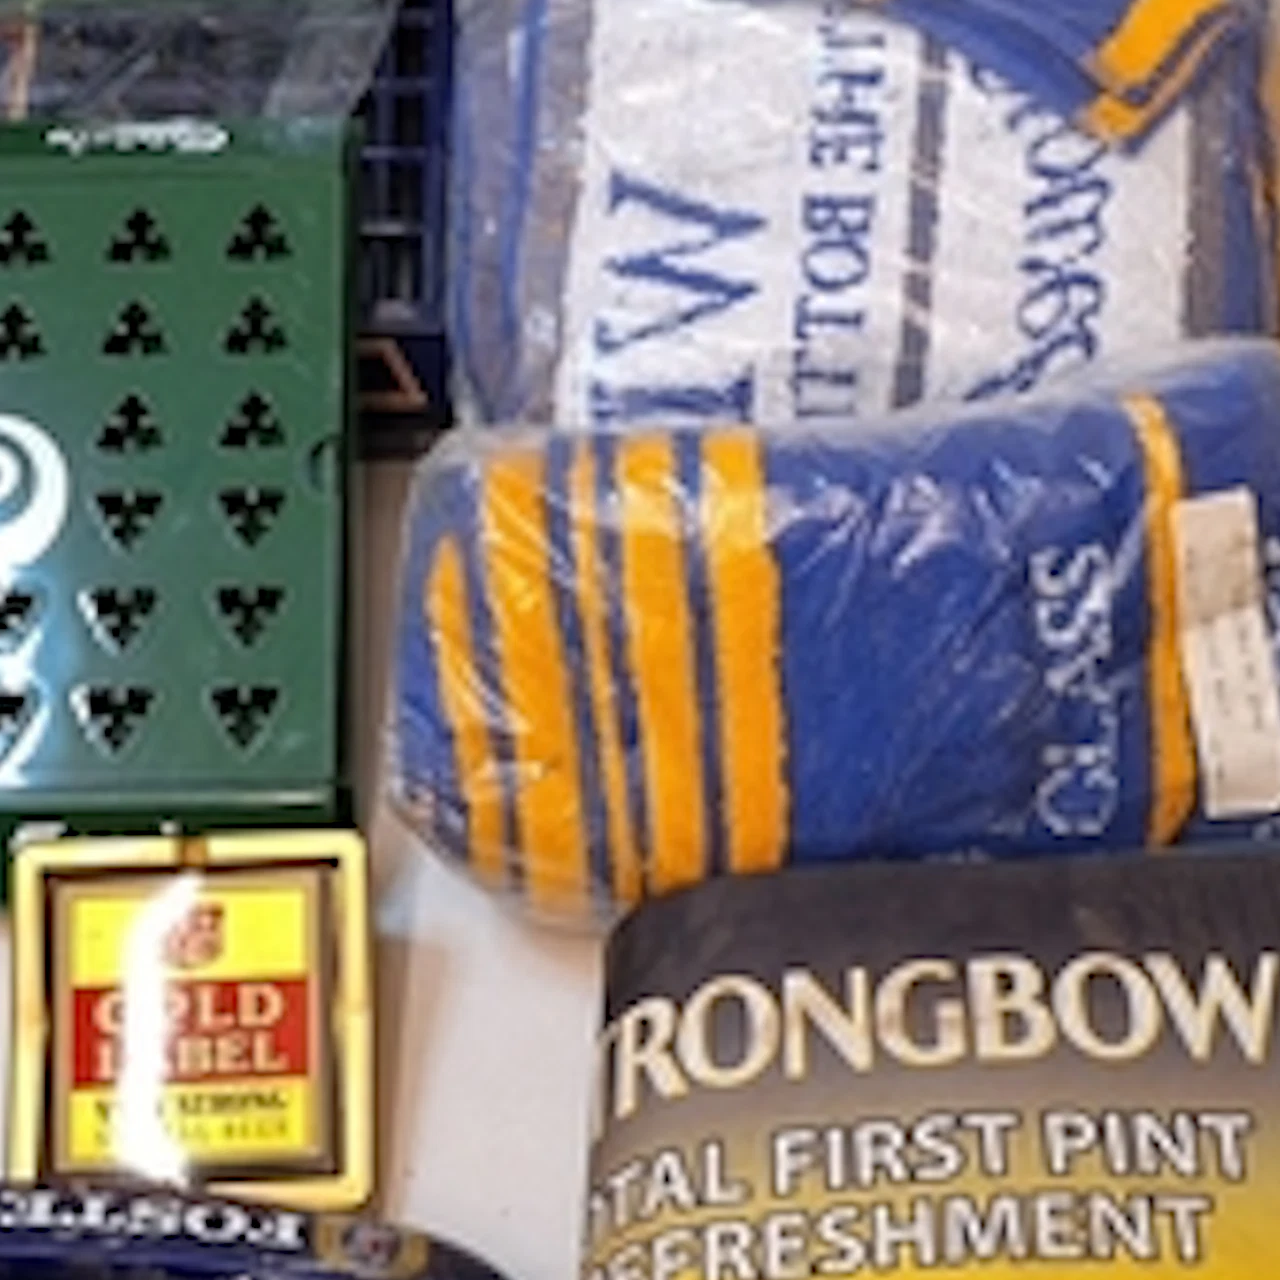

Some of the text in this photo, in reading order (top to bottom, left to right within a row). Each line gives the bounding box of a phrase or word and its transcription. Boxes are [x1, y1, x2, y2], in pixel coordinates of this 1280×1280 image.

[92, 982, 285, 1034] GLD
[94, 1029, 290, 1082] LBEL
[772, 1112, 1023, 1197] FIRST
[1042, 1111, 1251, 1181] PINT
